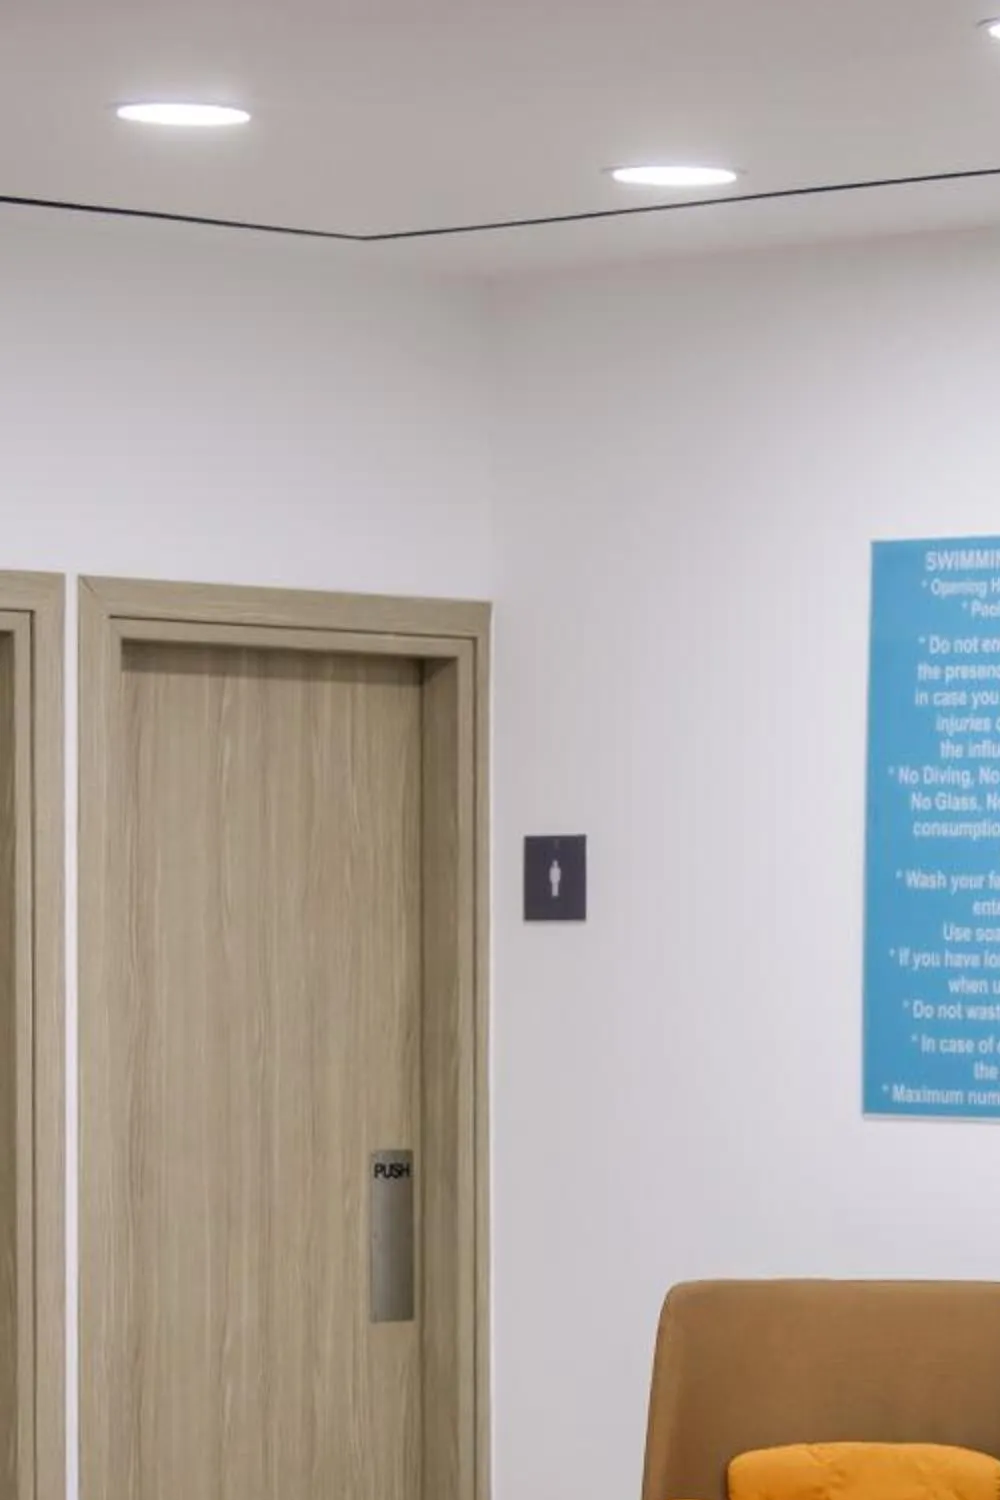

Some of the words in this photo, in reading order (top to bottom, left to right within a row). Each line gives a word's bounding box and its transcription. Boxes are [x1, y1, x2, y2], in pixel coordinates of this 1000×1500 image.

[931, 579, 987, 599] Opening
[971, 602, 1000, 618] Pool
[929, 635, 950, 654] Do
[954, 636, 979, 654] not
[918, 662, 941, 681] the
[916, 689, 928, 706] in
[933, 691, 968, 707] case
[972, 692, 999, 710] you
[936, 715, 991, 735] injuries
[940, 741, 963, 759] the
[898, 766, 919, 785] No
[979, 766, 1000, 784] No
[911, 792, 933, 810] No
[906, 870, 946, 888] Wash
[950, 871, 985, 892] your
[943, 924, 971, 941] Use
[899, 949, 909, 966] If
[912, 952, 940, 970] you
[945, 950, 980, 968] have
[949, 977, 988, 993] when
[912, 1001, 934, 1018] Do
[938, 1002, 962, 1019] not
[920, 1035, 935, 1052] In
[939, 1039, 974, 1053] case
[978, 1036, 994, 1053] of
[974, 1062, 997, 1079] the
[892, 1086, 963, 1103] Maximum
[374, 1162, 410, 1179] PUSH
